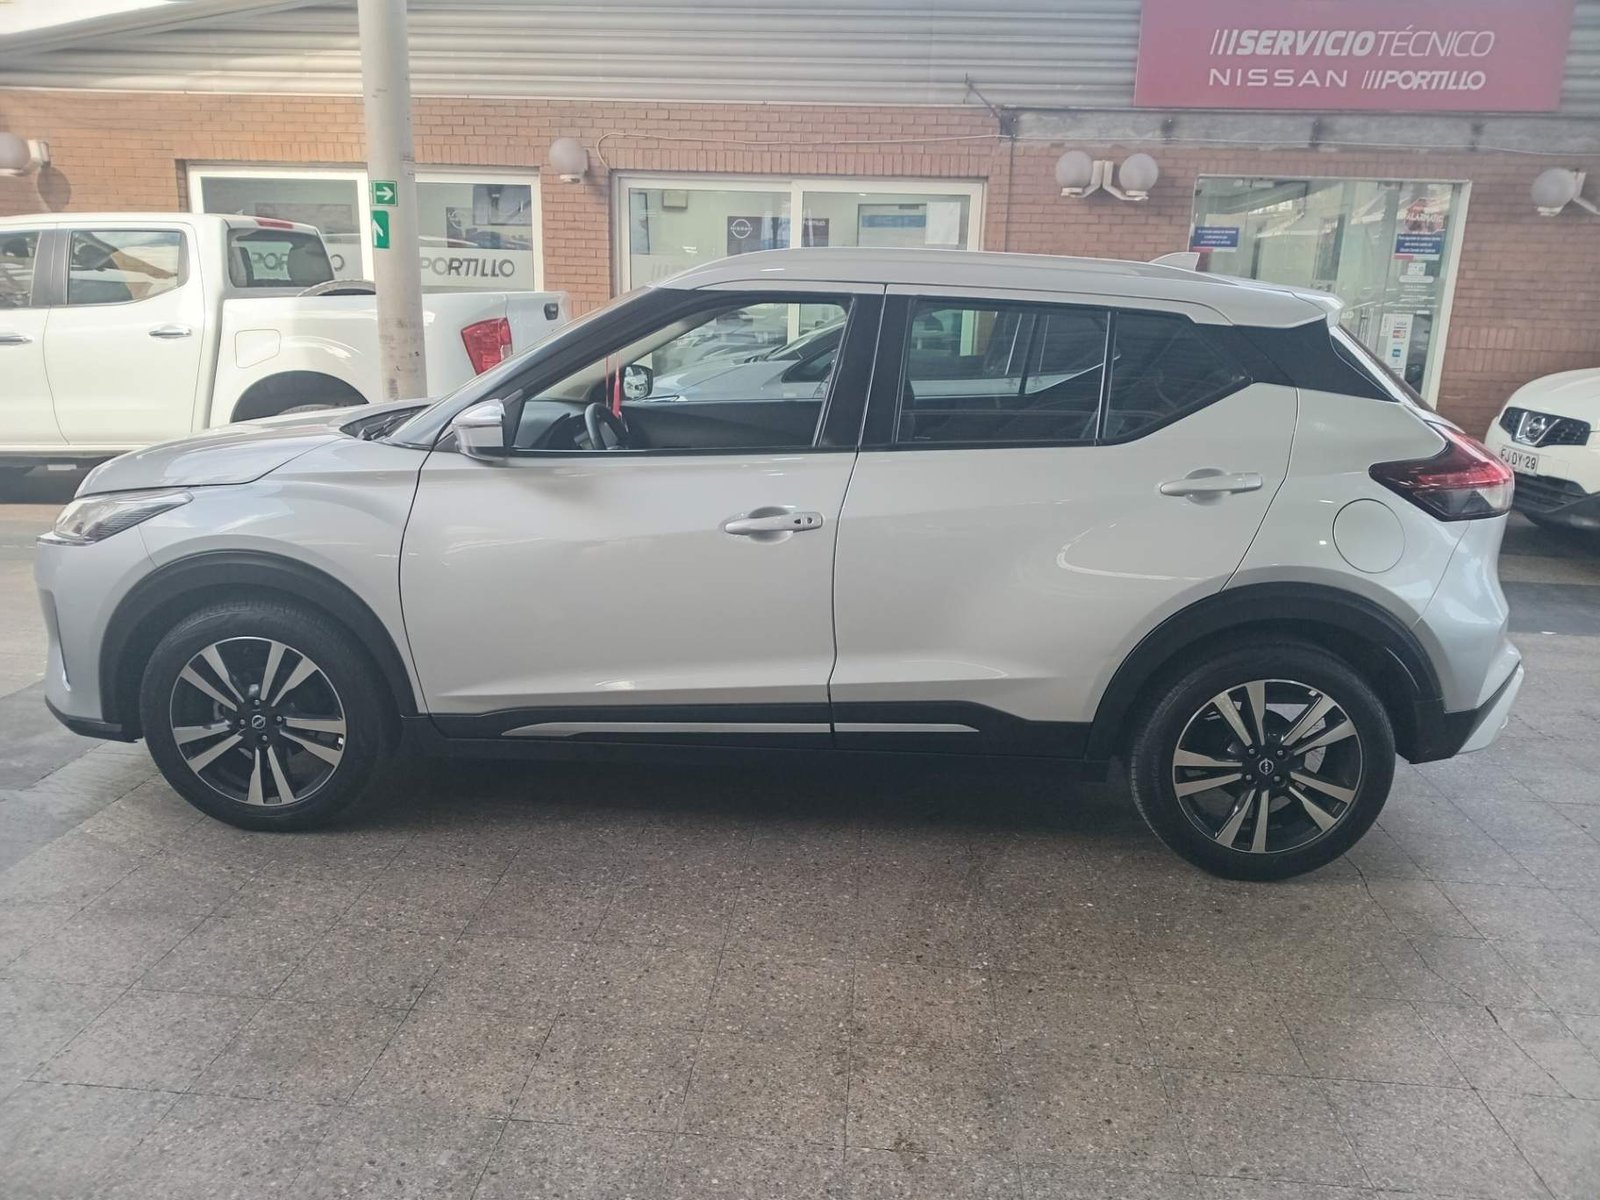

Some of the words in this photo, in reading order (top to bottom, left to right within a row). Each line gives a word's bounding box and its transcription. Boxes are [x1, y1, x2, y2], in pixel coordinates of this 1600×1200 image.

[1208, 68, 1348, 89] NISSAN
[1381, 70, 1486, 91] PORTILLO
[420, 256, 515, 278] PORTILLO
